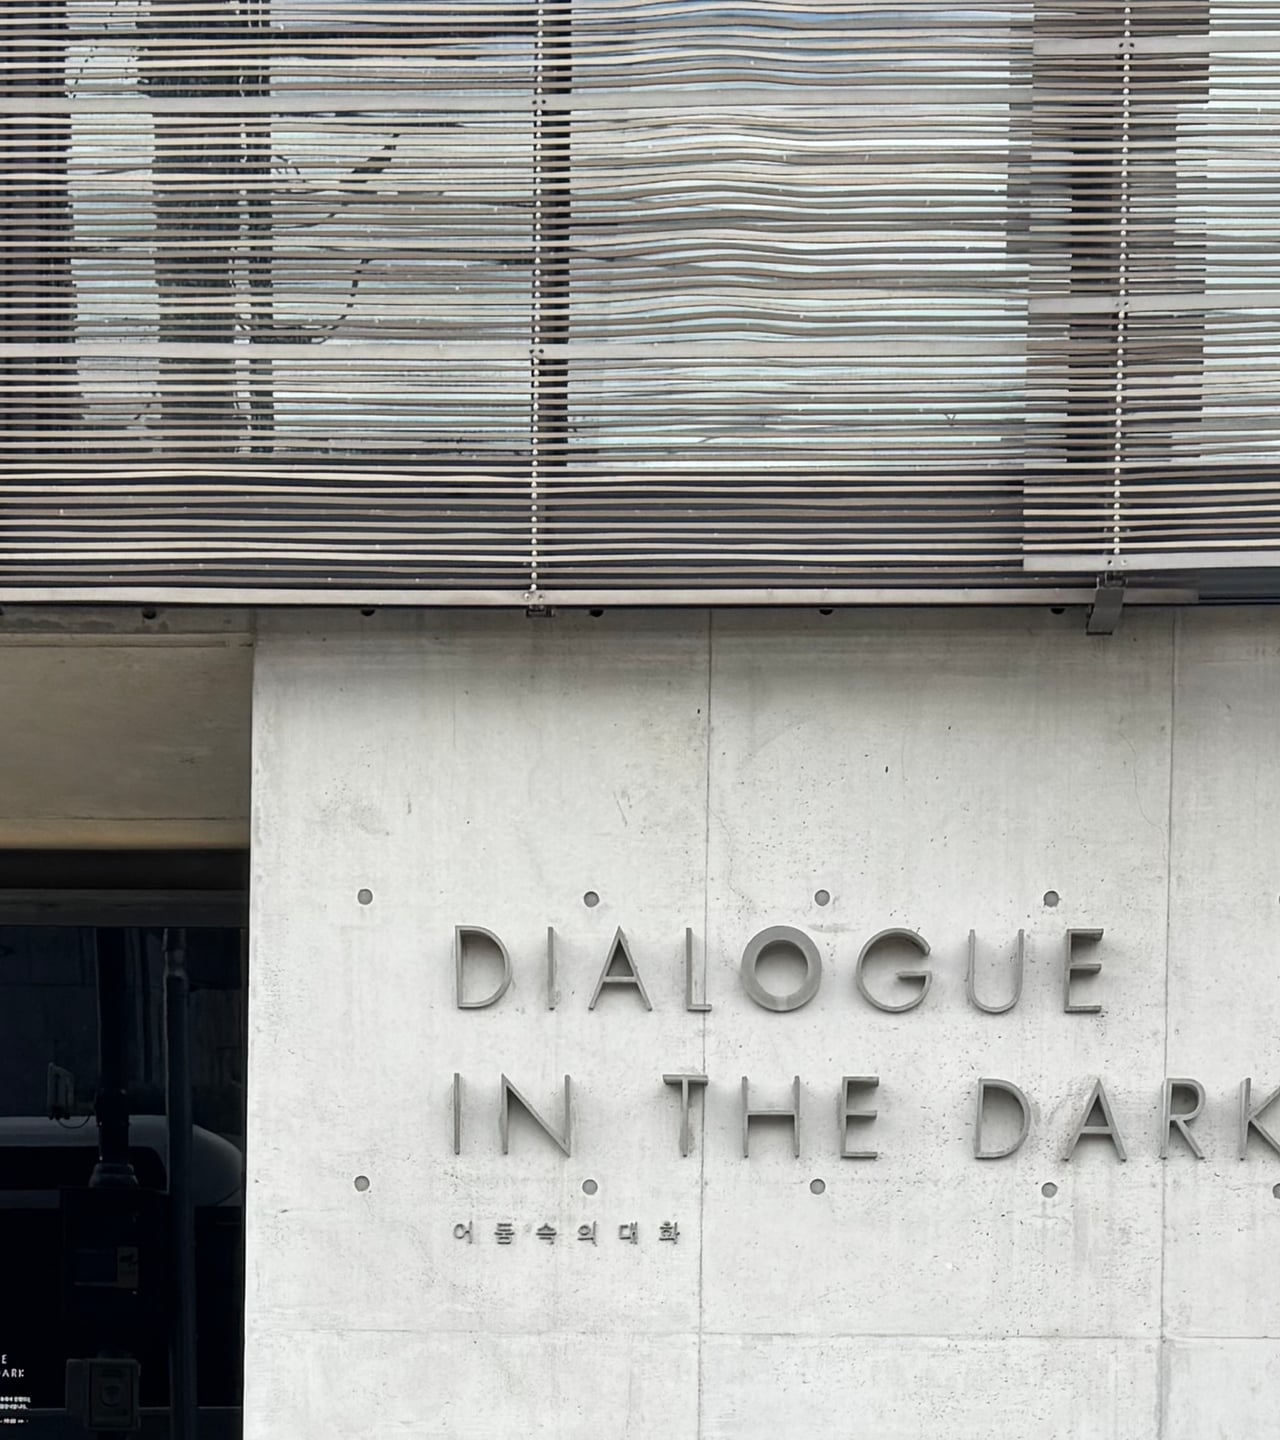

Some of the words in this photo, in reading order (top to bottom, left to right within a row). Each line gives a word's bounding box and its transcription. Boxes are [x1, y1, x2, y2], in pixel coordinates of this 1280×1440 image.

[455, 925, 1105, 1015] DIALOGUE
[453, 1071, 572, 1159] IN
[662, 1073, 880, 1161] THE
